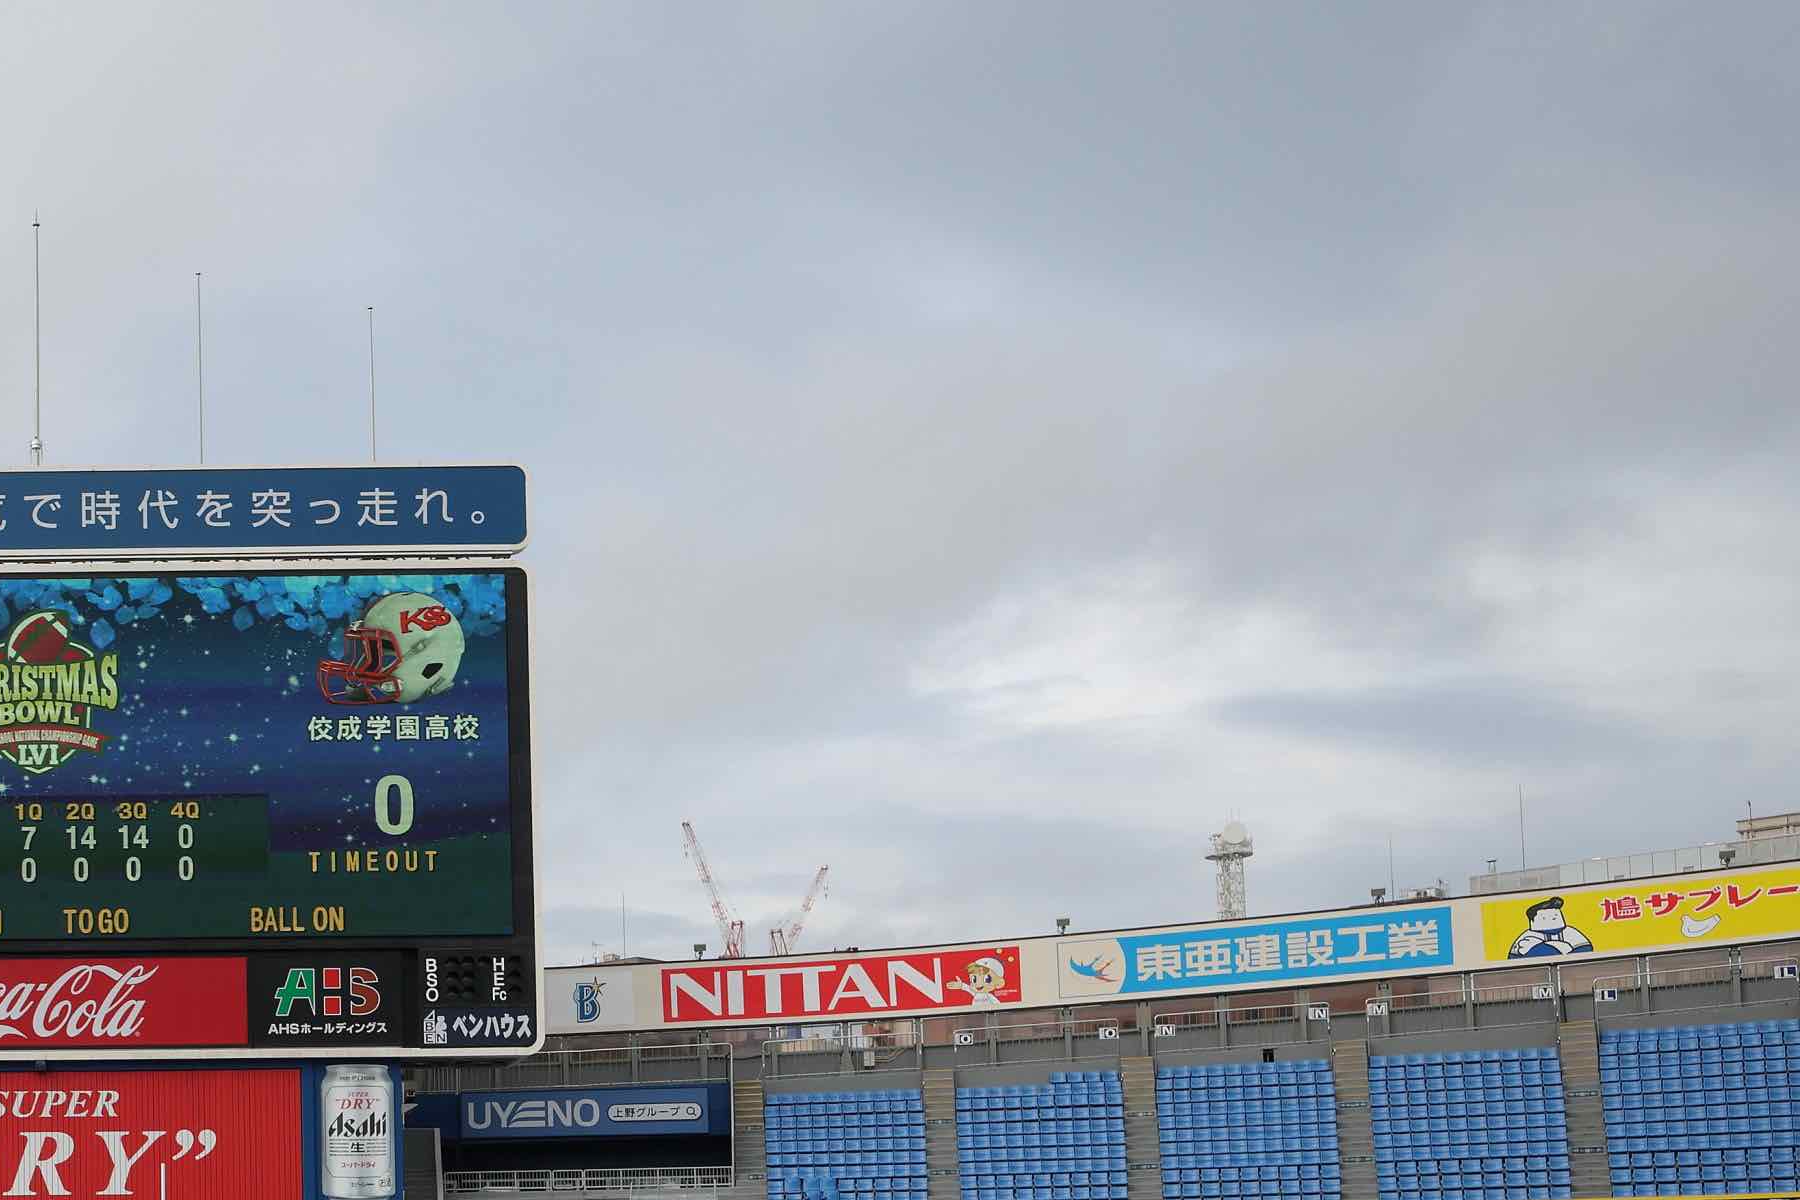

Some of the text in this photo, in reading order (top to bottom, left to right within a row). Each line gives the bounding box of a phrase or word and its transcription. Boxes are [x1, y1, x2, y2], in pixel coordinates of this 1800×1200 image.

[307, 714, 480, 742] 佼成学園高校
[18, 744, 59, 765] LVI
[15, 803, 200, 821] 1Q 2Q 3Q 4Q
[374, 774, 414, 835] 0
[21, 826, 36, 851] 7
[64, 825, 97, 850] 14
[118, 825, 149, 849] 14
[178, 824, 193, 848] 0
[21, 858, 37, 883] 0
[73, 857, 89, 882] 0
[126, 857, 142, 882] 0
[178, 856, 193, 881] 0
[308, 851, 439, 873] TIMEOUT
[1600, 884, 1798, 922] 鳩サブレー
[251, 906, 345, 932] BALL ON
[1136, 920, 1440, 983] 東亜建設工業
[425, 958, 437, 972] B
[492, 957, 505, 972] H
[426, 972, 438, 987] S
[493, 972, 505, 986] E
[670, 957, 945, 1018] NITTAN
[426, 988, 439, 1002] O
[1539, 988, 1552, 998] M
[1372, 1003, 1386, 1015] M
[268, 1021, 388, 1035] AHSホールディングス
[467, 1098, 600, 1130] UYENO
[613, 1105, 680, 1119] 上野グループ
[328, 1111, 387, 1138] Asahi
[350, 1142, 366, 1153] 生
